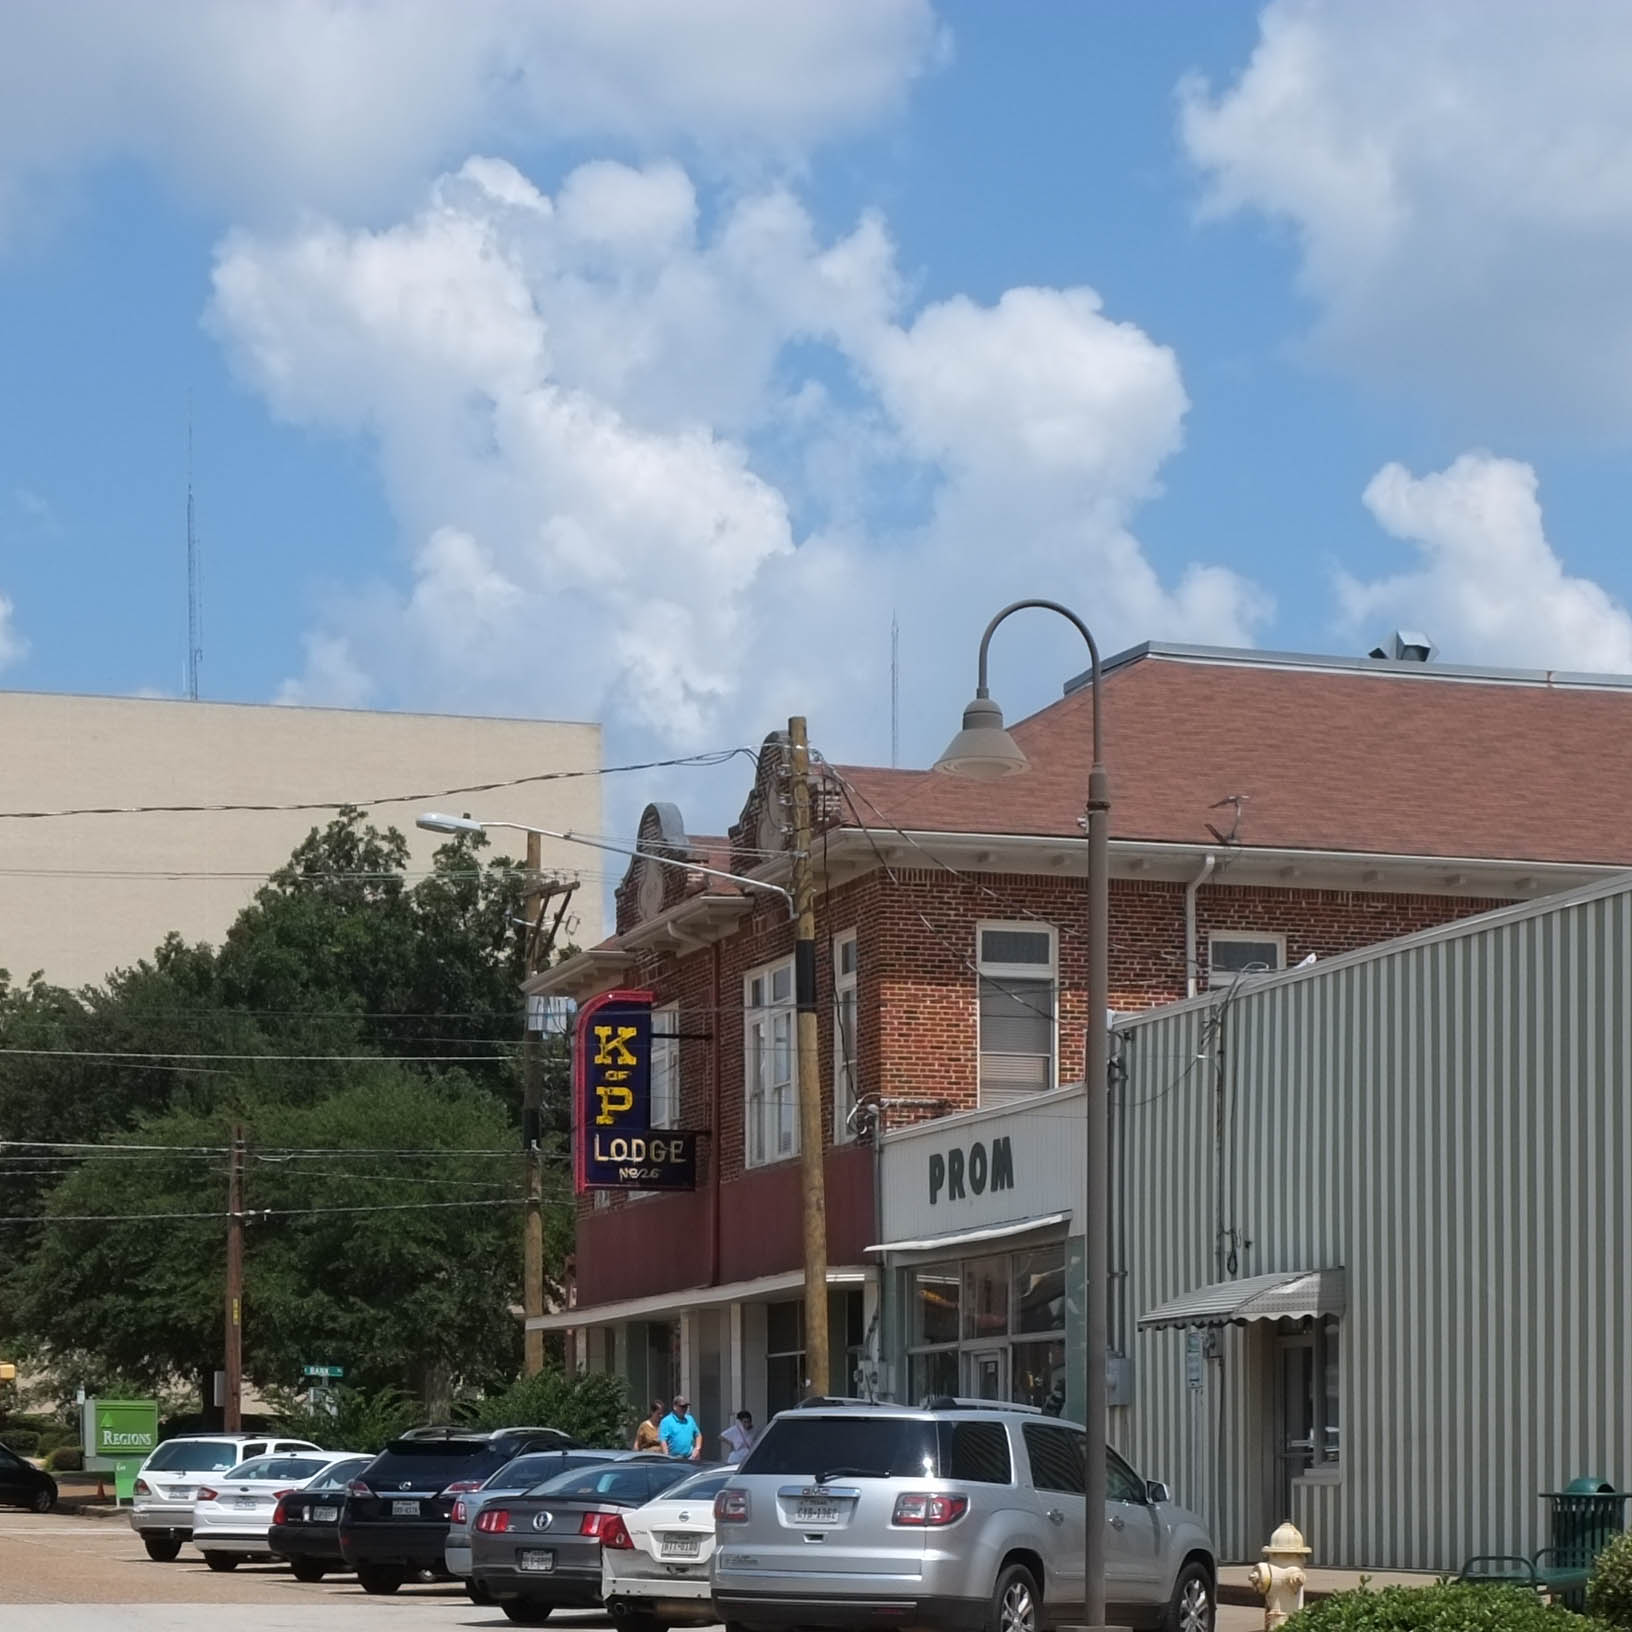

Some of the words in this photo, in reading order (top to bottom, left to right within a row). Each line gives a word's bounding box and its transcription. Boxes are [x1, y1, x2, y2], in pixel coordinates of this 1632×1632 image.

[594, 1026, 637, 1065] K
[604, 1070, 631, 1081] OF
[595, 1086, 634, 1125] P
[594, 1133, 687, 1163] LODGE
[928, 1135, 1015, 1205] PROM
[802, 1488, 830, 1496] GMC
